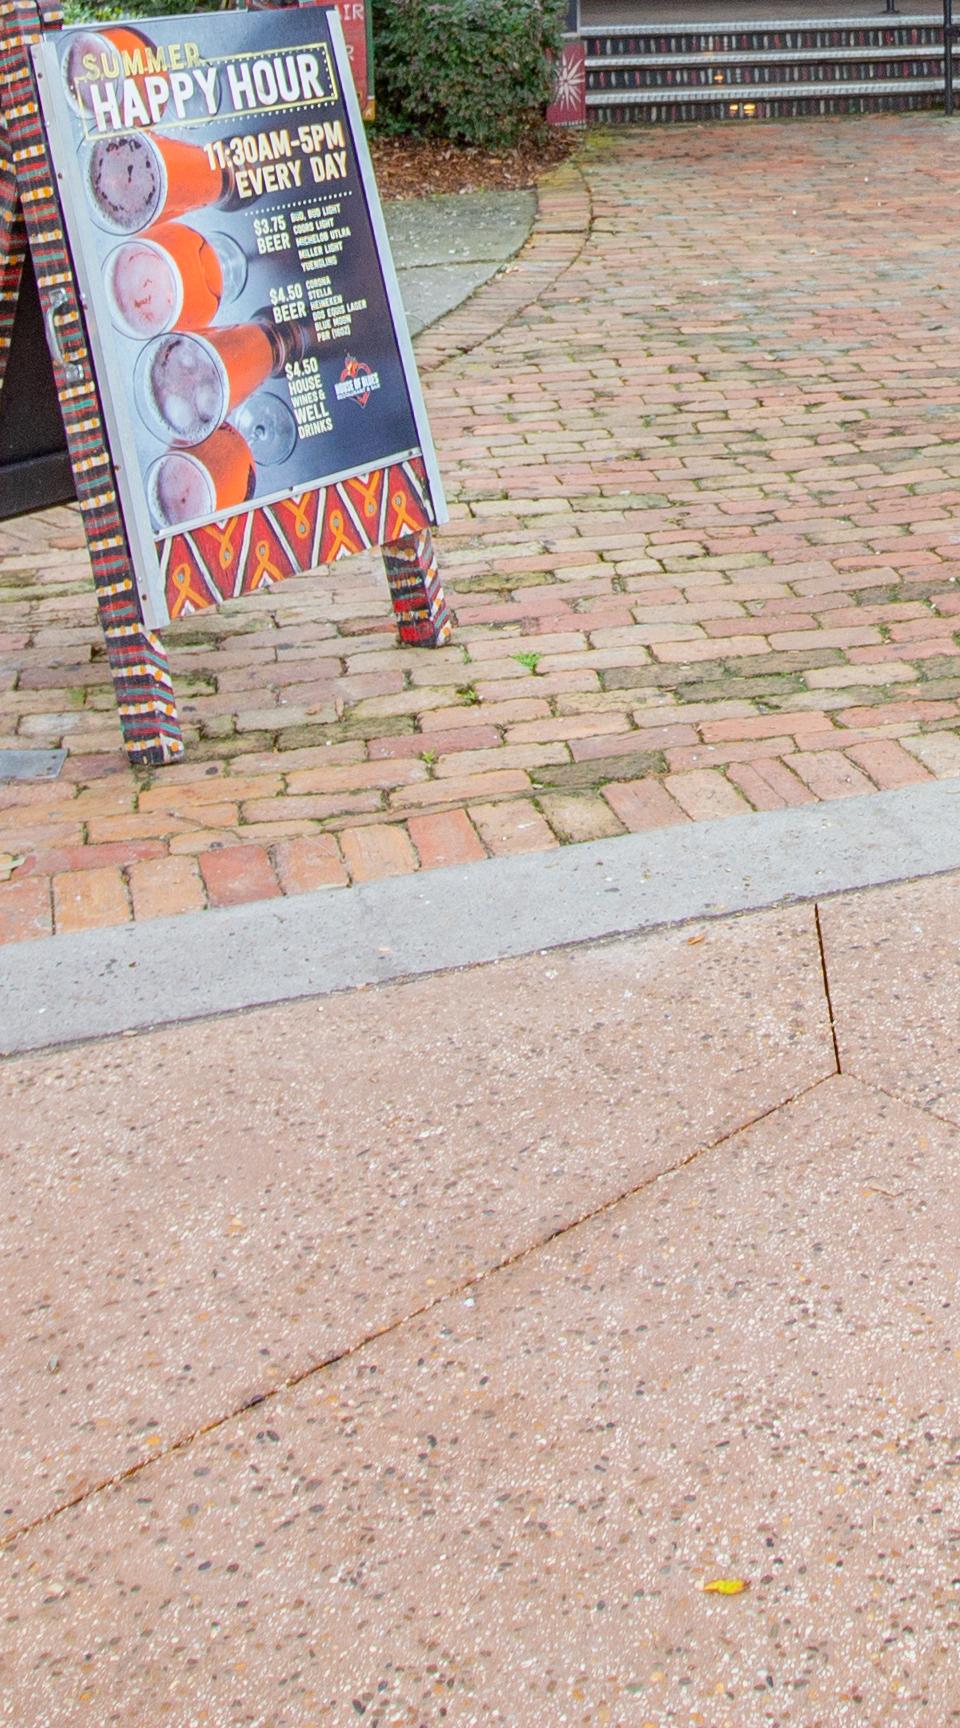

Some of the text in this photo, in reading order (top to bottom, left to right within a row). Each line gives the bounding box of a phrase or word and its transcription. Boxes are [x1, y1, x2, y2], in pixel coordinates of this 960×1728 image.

[83, 42, 201, 80] SUMMER
[90, 53, 324, 131] HAPPY HOUR
[203, 120, 346, 170] 11:30AM-5PM
[235, 151, 348, 199] EVERY DAY
[322, 203, 341, 216] LIGHT
[253, 215, 287, 236] $3.75
[293, 217, 334, 235] COORS LIGHT
[256, 232, 291, 254] BEER
[298, 240, 343, 260] MILLER LIGHT
[269, 283, 303, 306] $4.50
[308, 286, 333, 300] STELLA
[310, 294, 343, 311] HEINEKEN
[273, 301, 307, 324] BEER
[346, 298, 368, 313] LAGER
[285, 357, 319, 381] $4.50
[288, 374, 323, 396] HOUSE
[291, 391, 319, 408] WINES
[294, 402, 329, 425] WELL
[298, 417, 333, 440] DRINKS
